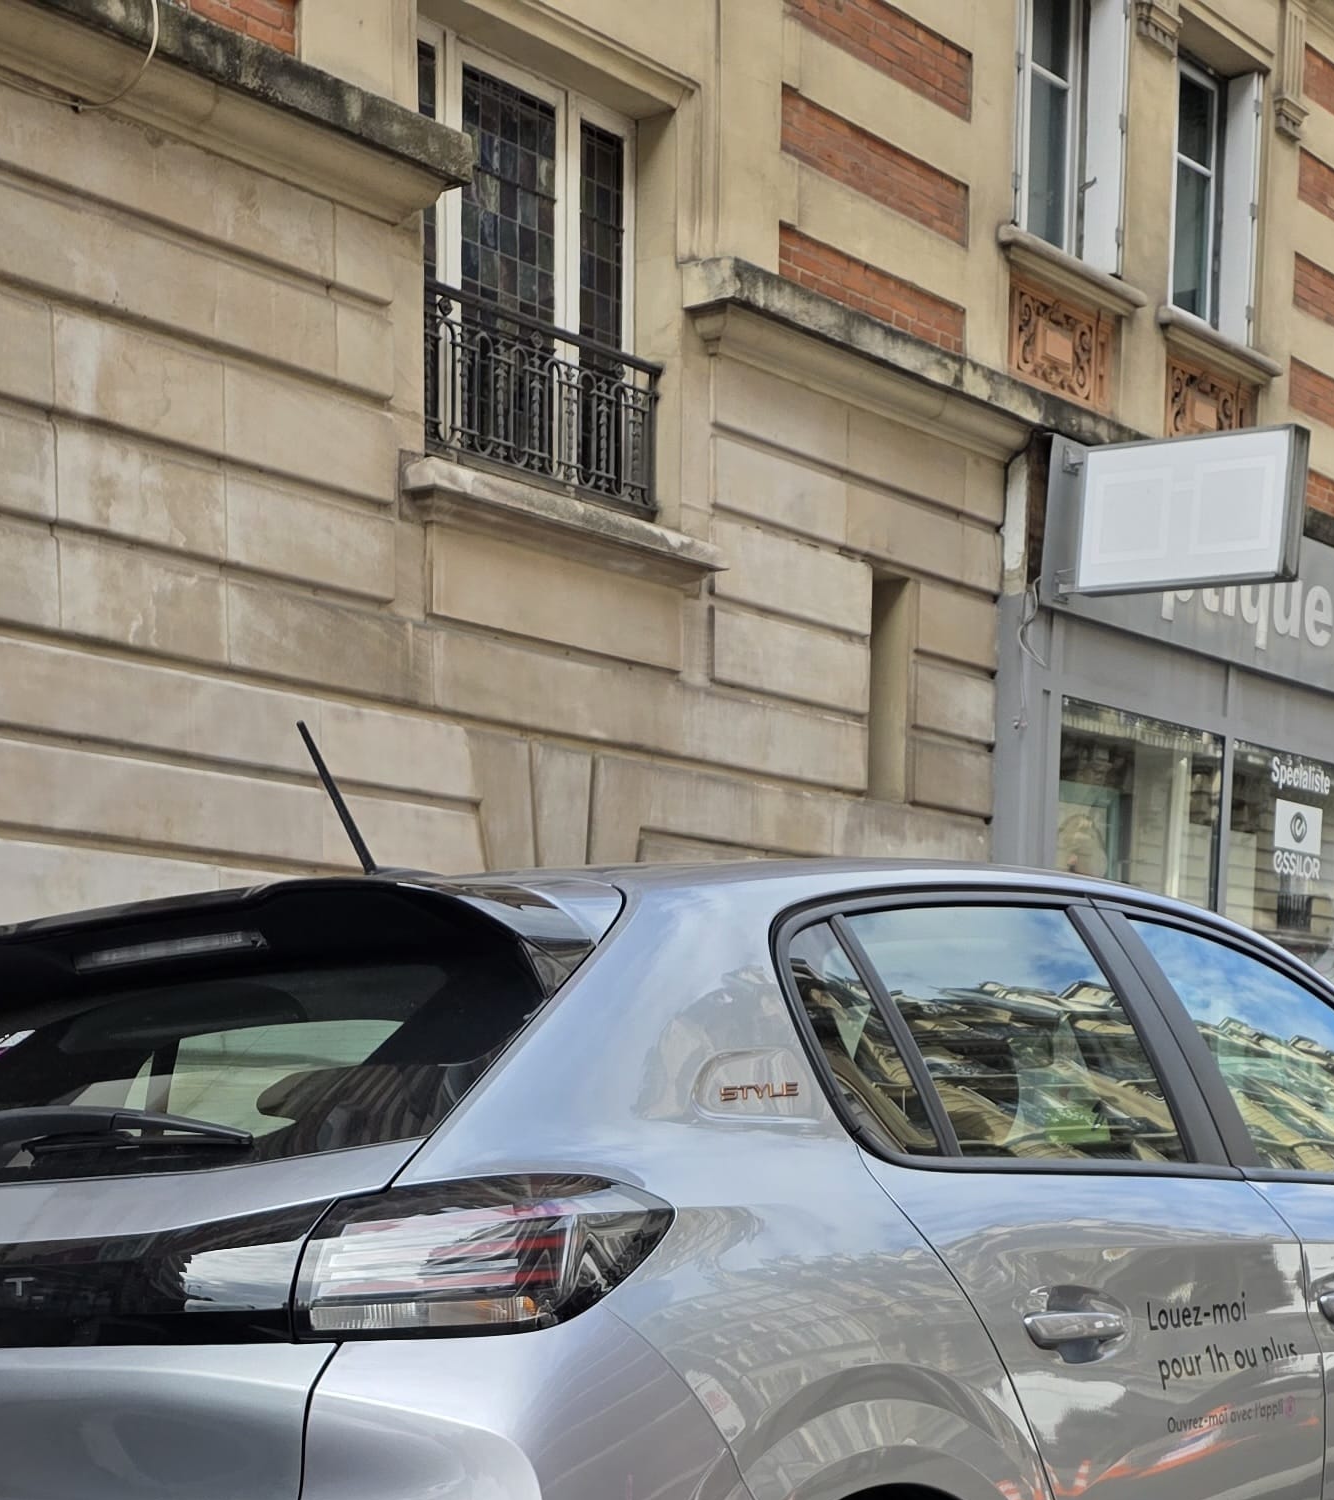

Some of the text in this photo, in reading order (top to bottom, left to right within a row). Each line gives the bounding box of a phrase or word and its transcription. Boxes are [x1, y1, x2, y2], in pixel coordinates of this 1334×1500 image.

[720, 1081, 800, 1101] STYLE
[1147, 1292, 1247, 1331] Louez-moi
[1158, 1353, 1202, 1390] pour
[1205, 1343, 1230, 1374] 1h
[1234, 1346, 1258, 1370] ou
[1167, 1407, 1228, 1434] Ouvrez-moi
[1230, 1408, 1253, 1423] avec
